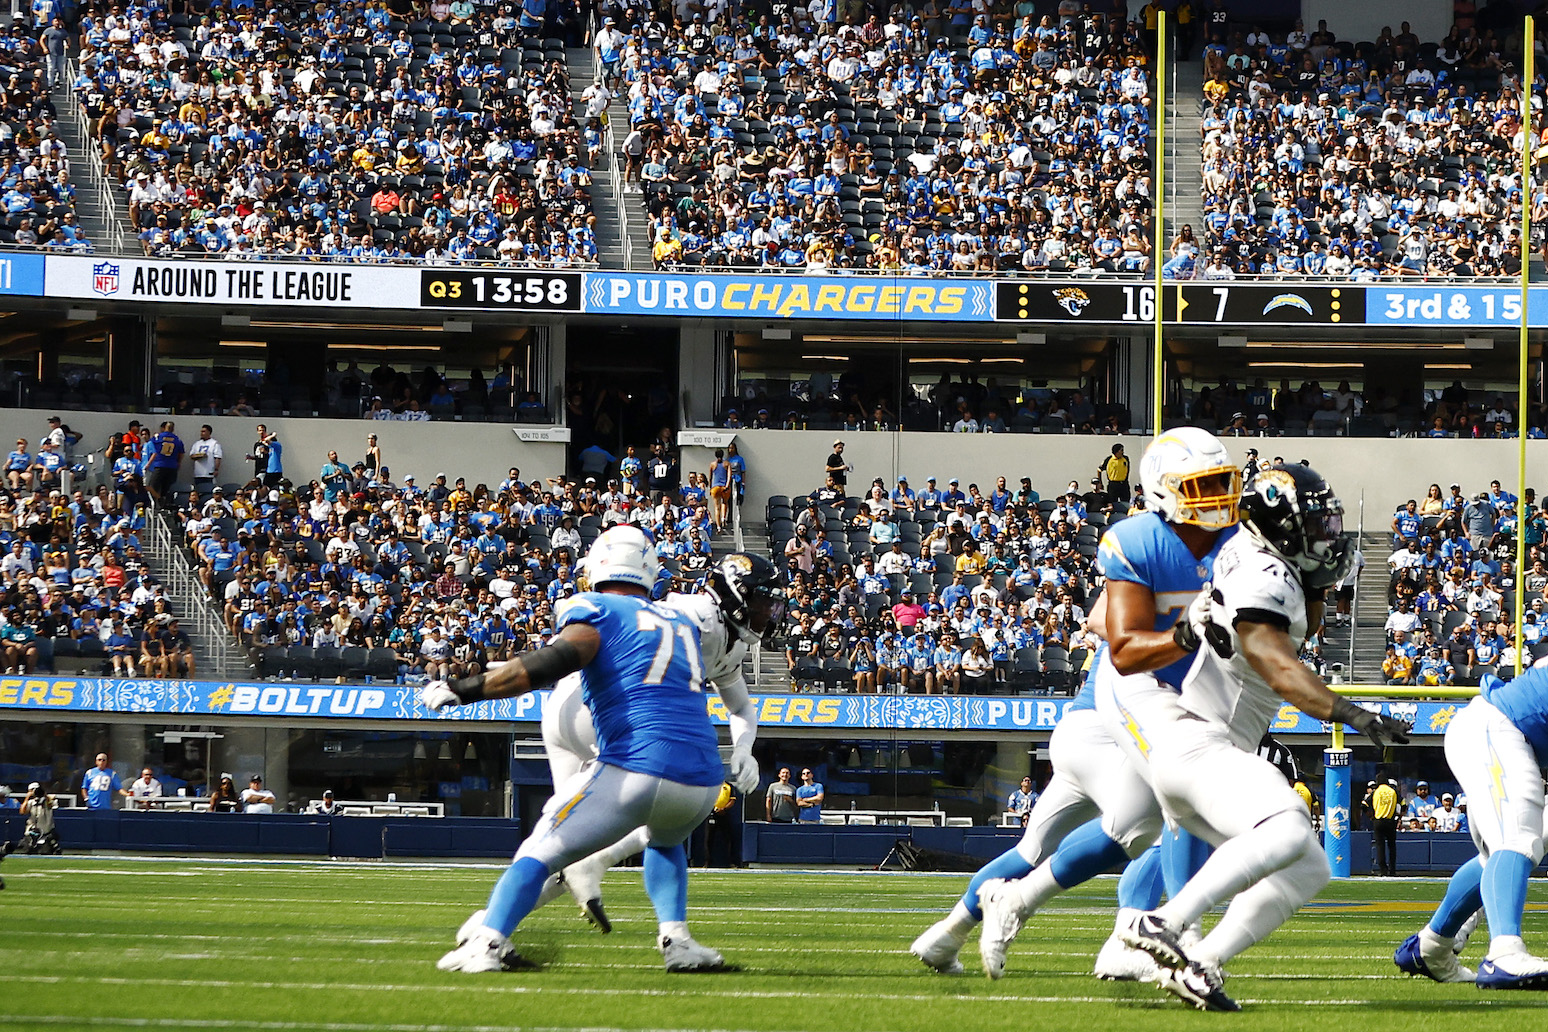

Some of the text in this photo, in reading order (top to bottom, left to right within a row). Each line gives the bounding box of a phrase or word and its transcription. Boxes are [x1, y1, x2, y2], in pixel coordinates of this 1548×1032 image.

[772, 4, 785, 15] 97
[1212, 12, 1227, 22] 33
[1086, 34, 1101, 48] 24
[88, 94, 104, 107] 97
[501, 202, 513, 214] 10
[95, 276, 119, 292] NFL
[132, 266, 353, 302] AROUND THE LEAGUE
[429, 275, 568, 305] Q3 13:58
[1122, 286, 1156, 322] 16
[1213, 286, 1229, 322] 7
[1384, 293, 1521, 321] 3rd & 15
[654, 463, 667, 478] 10
[688, 556, 707, 568] 97
[490, 631, 504, 644] 10
[454, 644, 470, 658] 97
[636, 610, 703, 693] 71
[208, 684, 385, 715] #BOLTUP
[90, 776, 110, 791] 49
